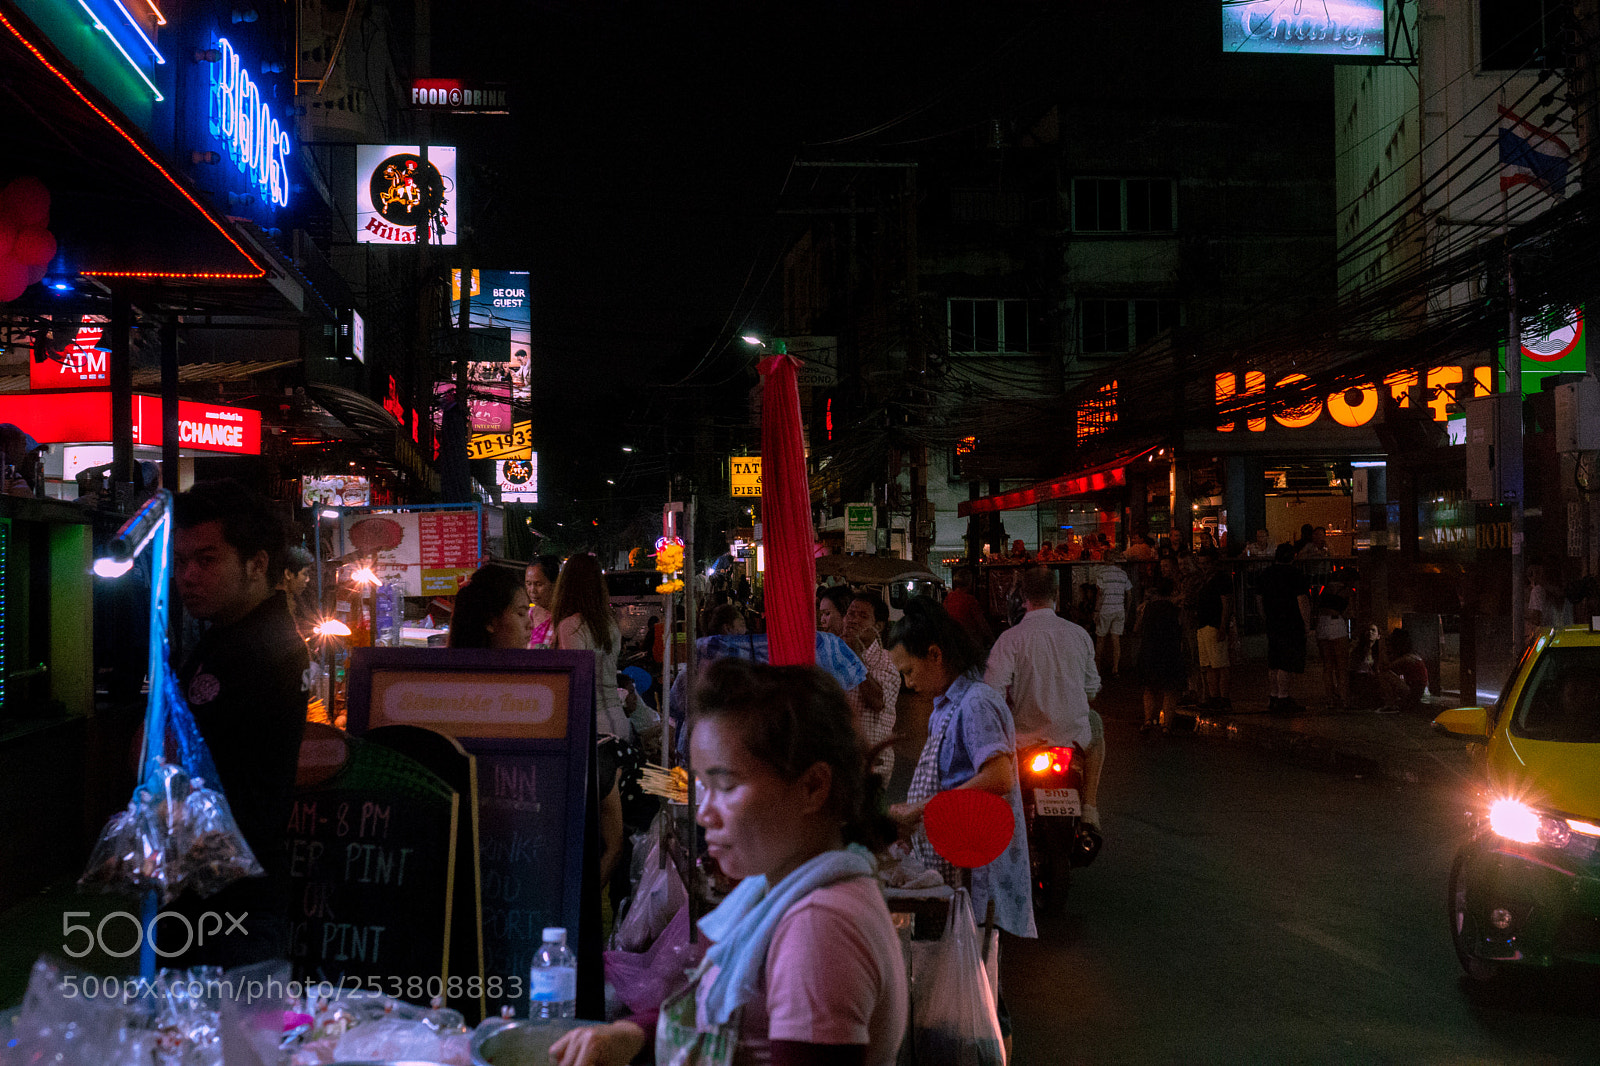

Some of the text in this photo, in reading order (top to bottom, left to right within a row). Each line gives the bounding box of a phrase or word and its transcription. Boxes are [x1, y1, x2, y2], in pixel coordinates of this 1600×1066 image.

[411, 87, 448, 105] FOOD
[463, 88, 507, 106] DRINK
[365, 217, 431, 243] Hilla
[492, 288, 526, 298] BE OUR
[492, 298, 523, 308] GUEST
[60, 351, 107, 374] ATM
[733, 486, 762, 495] PIER
[359, 801, 391, 838] PM
[345, 842, 414, 886] PINT
[321, 922, 387, 964] PINT
